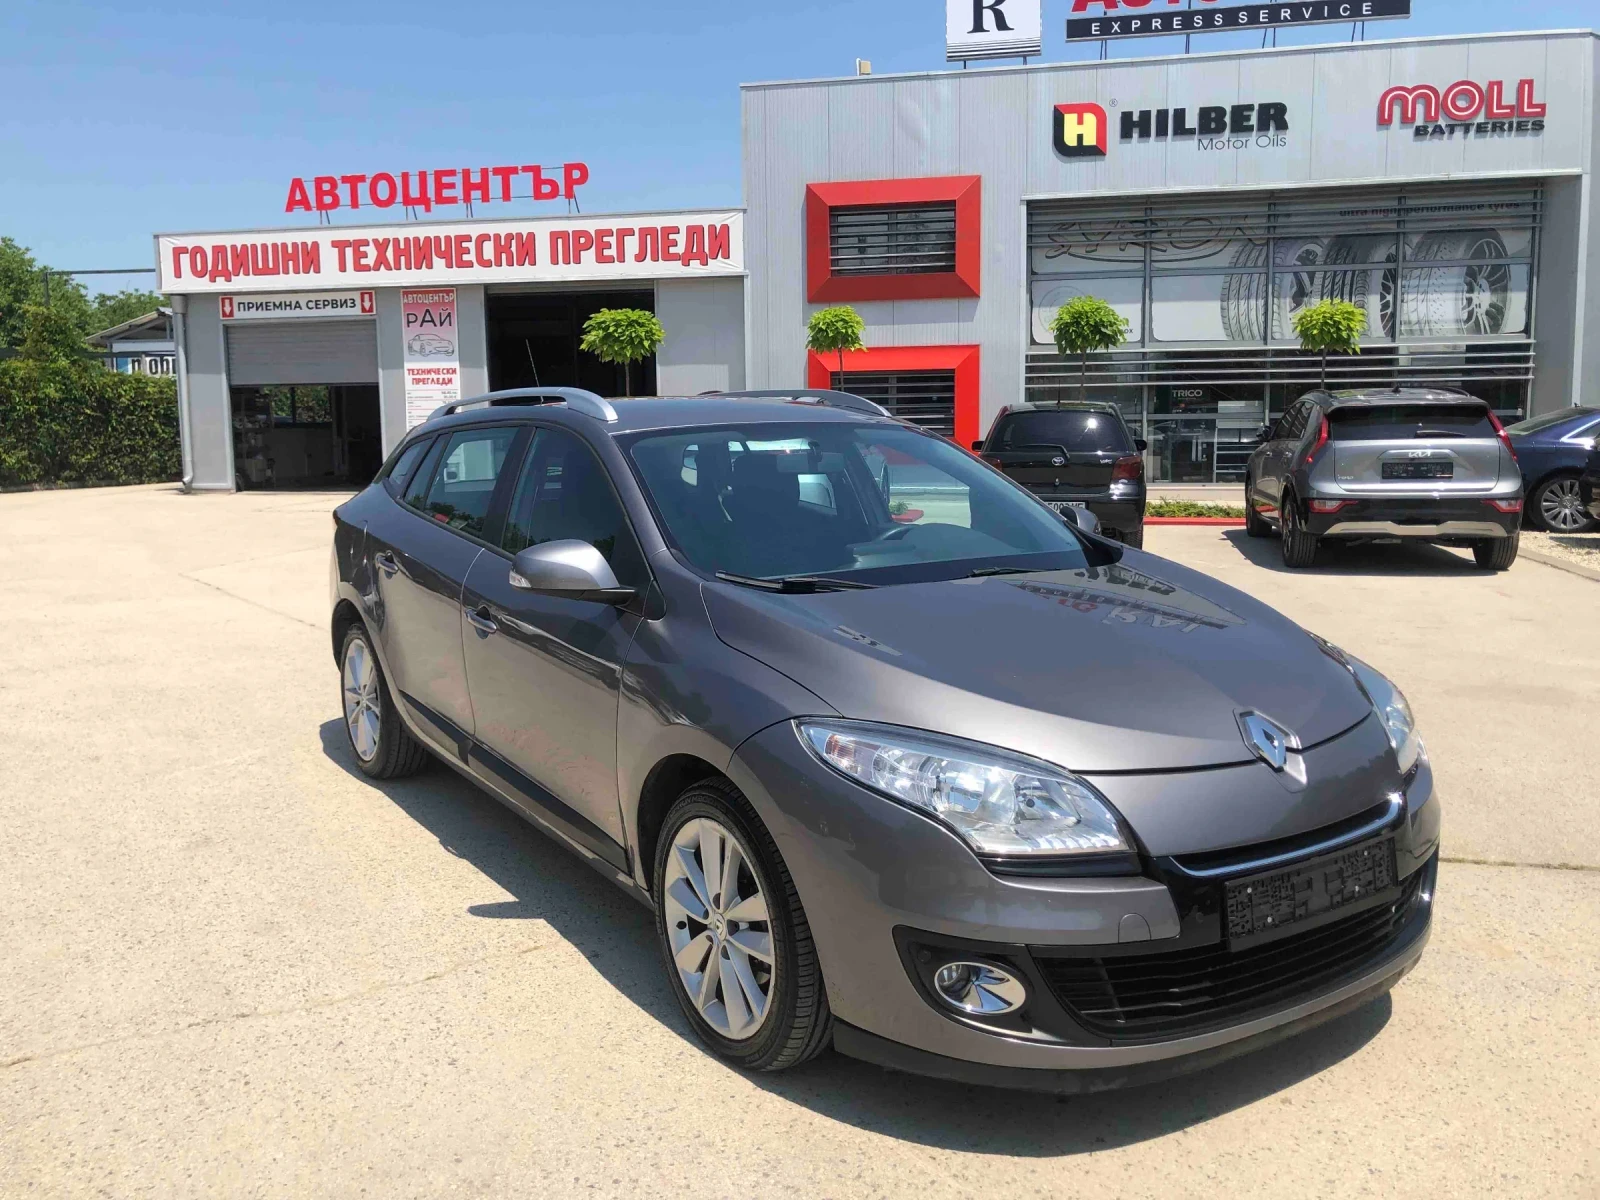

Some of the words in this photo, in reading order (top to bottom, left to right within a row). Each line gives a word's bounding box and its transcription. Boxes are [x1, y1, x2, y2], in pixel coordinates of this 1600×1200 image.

[967, 0, 1015, 34] R
[1091, 14, 1223, 35] EXPRESS
[1238, 2, 1372, 24] SERVICE
[1120, 102, 1289, 139] HILBER
[1415, 119, 1545, 137] BATTERIES
[1197, 137, 1250, 151] Motor
[1255, 134, 1288, 149] Oils
[285, 162, 589, 213] АВТОЦЕНТЪР
[172, 241, 321, 283] ГОДИШНИ
[331, 231, 537, 273] ТЕХНИЧЕСКИ
[549, 223, 730, 267] ПРЕГЛЕДИ
[237, 299, 303, 312] ПРИЕМНА
[305, 297, 357, 310] СЕРВИЗ
[403, 293, 454, 304] АВТОЦЕНТЪР
[407, 367, 457, 376] ТЕХНИЧЕСКИ
[411, 377, 453, 386] ПРЕГЛЕДИ
[1172, 389, 1203, 398] TRICO
